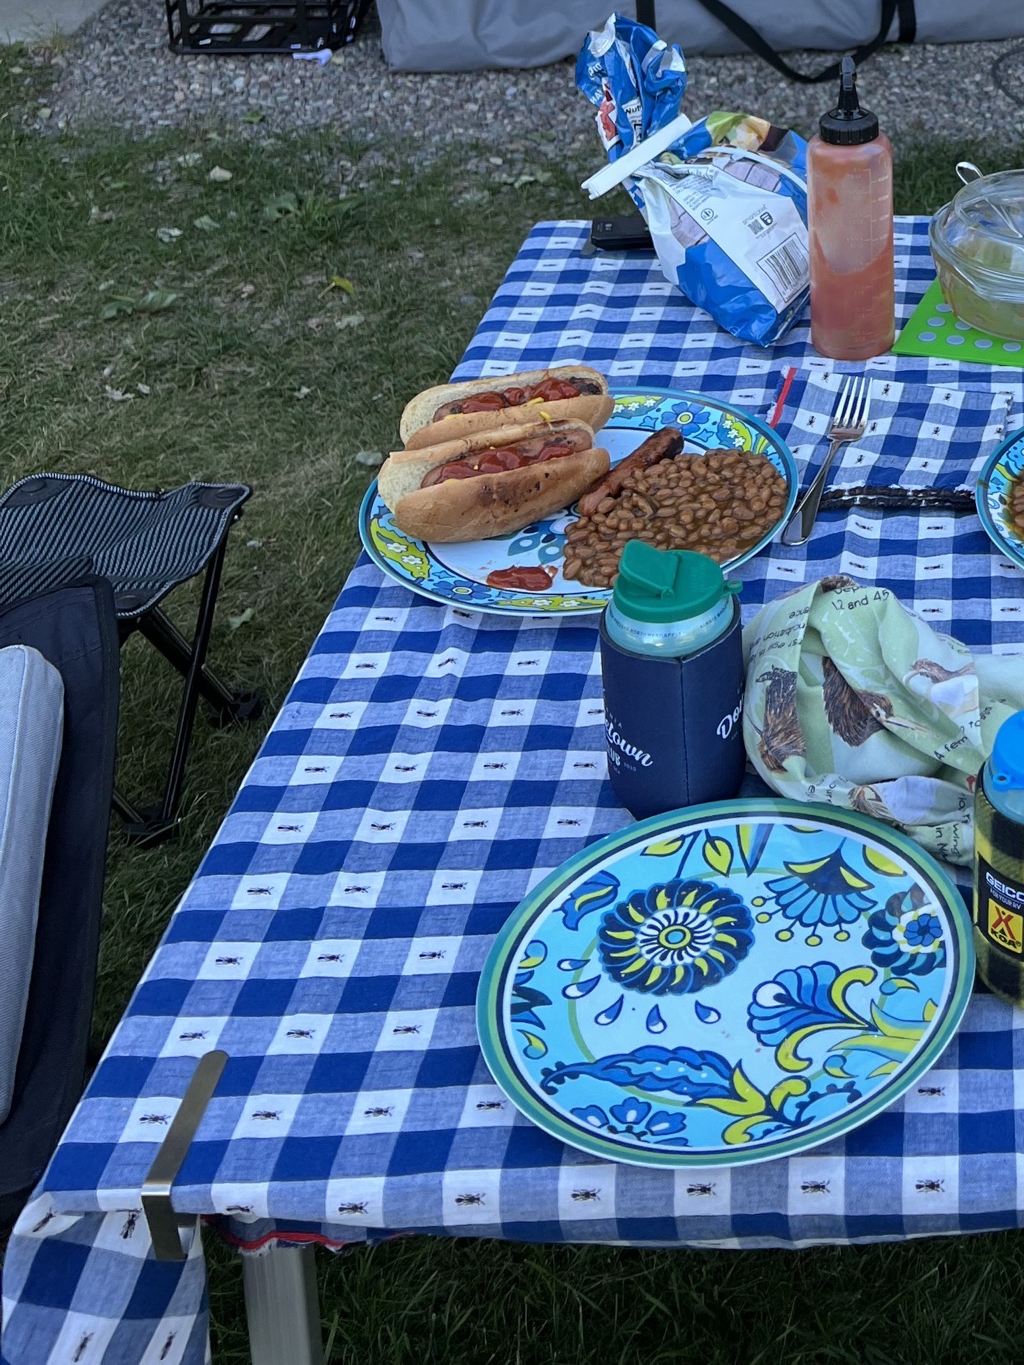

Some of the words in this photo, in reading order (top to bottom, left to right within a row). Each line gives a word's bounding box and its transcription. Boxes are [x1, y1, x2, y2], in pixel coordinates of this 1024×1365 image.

[847, 596, 869, 611] and
[873, 590, 890, 602] 45
[998, 895, 1012, 907] YOUR
[990, 927, 1017, 949] KOA
